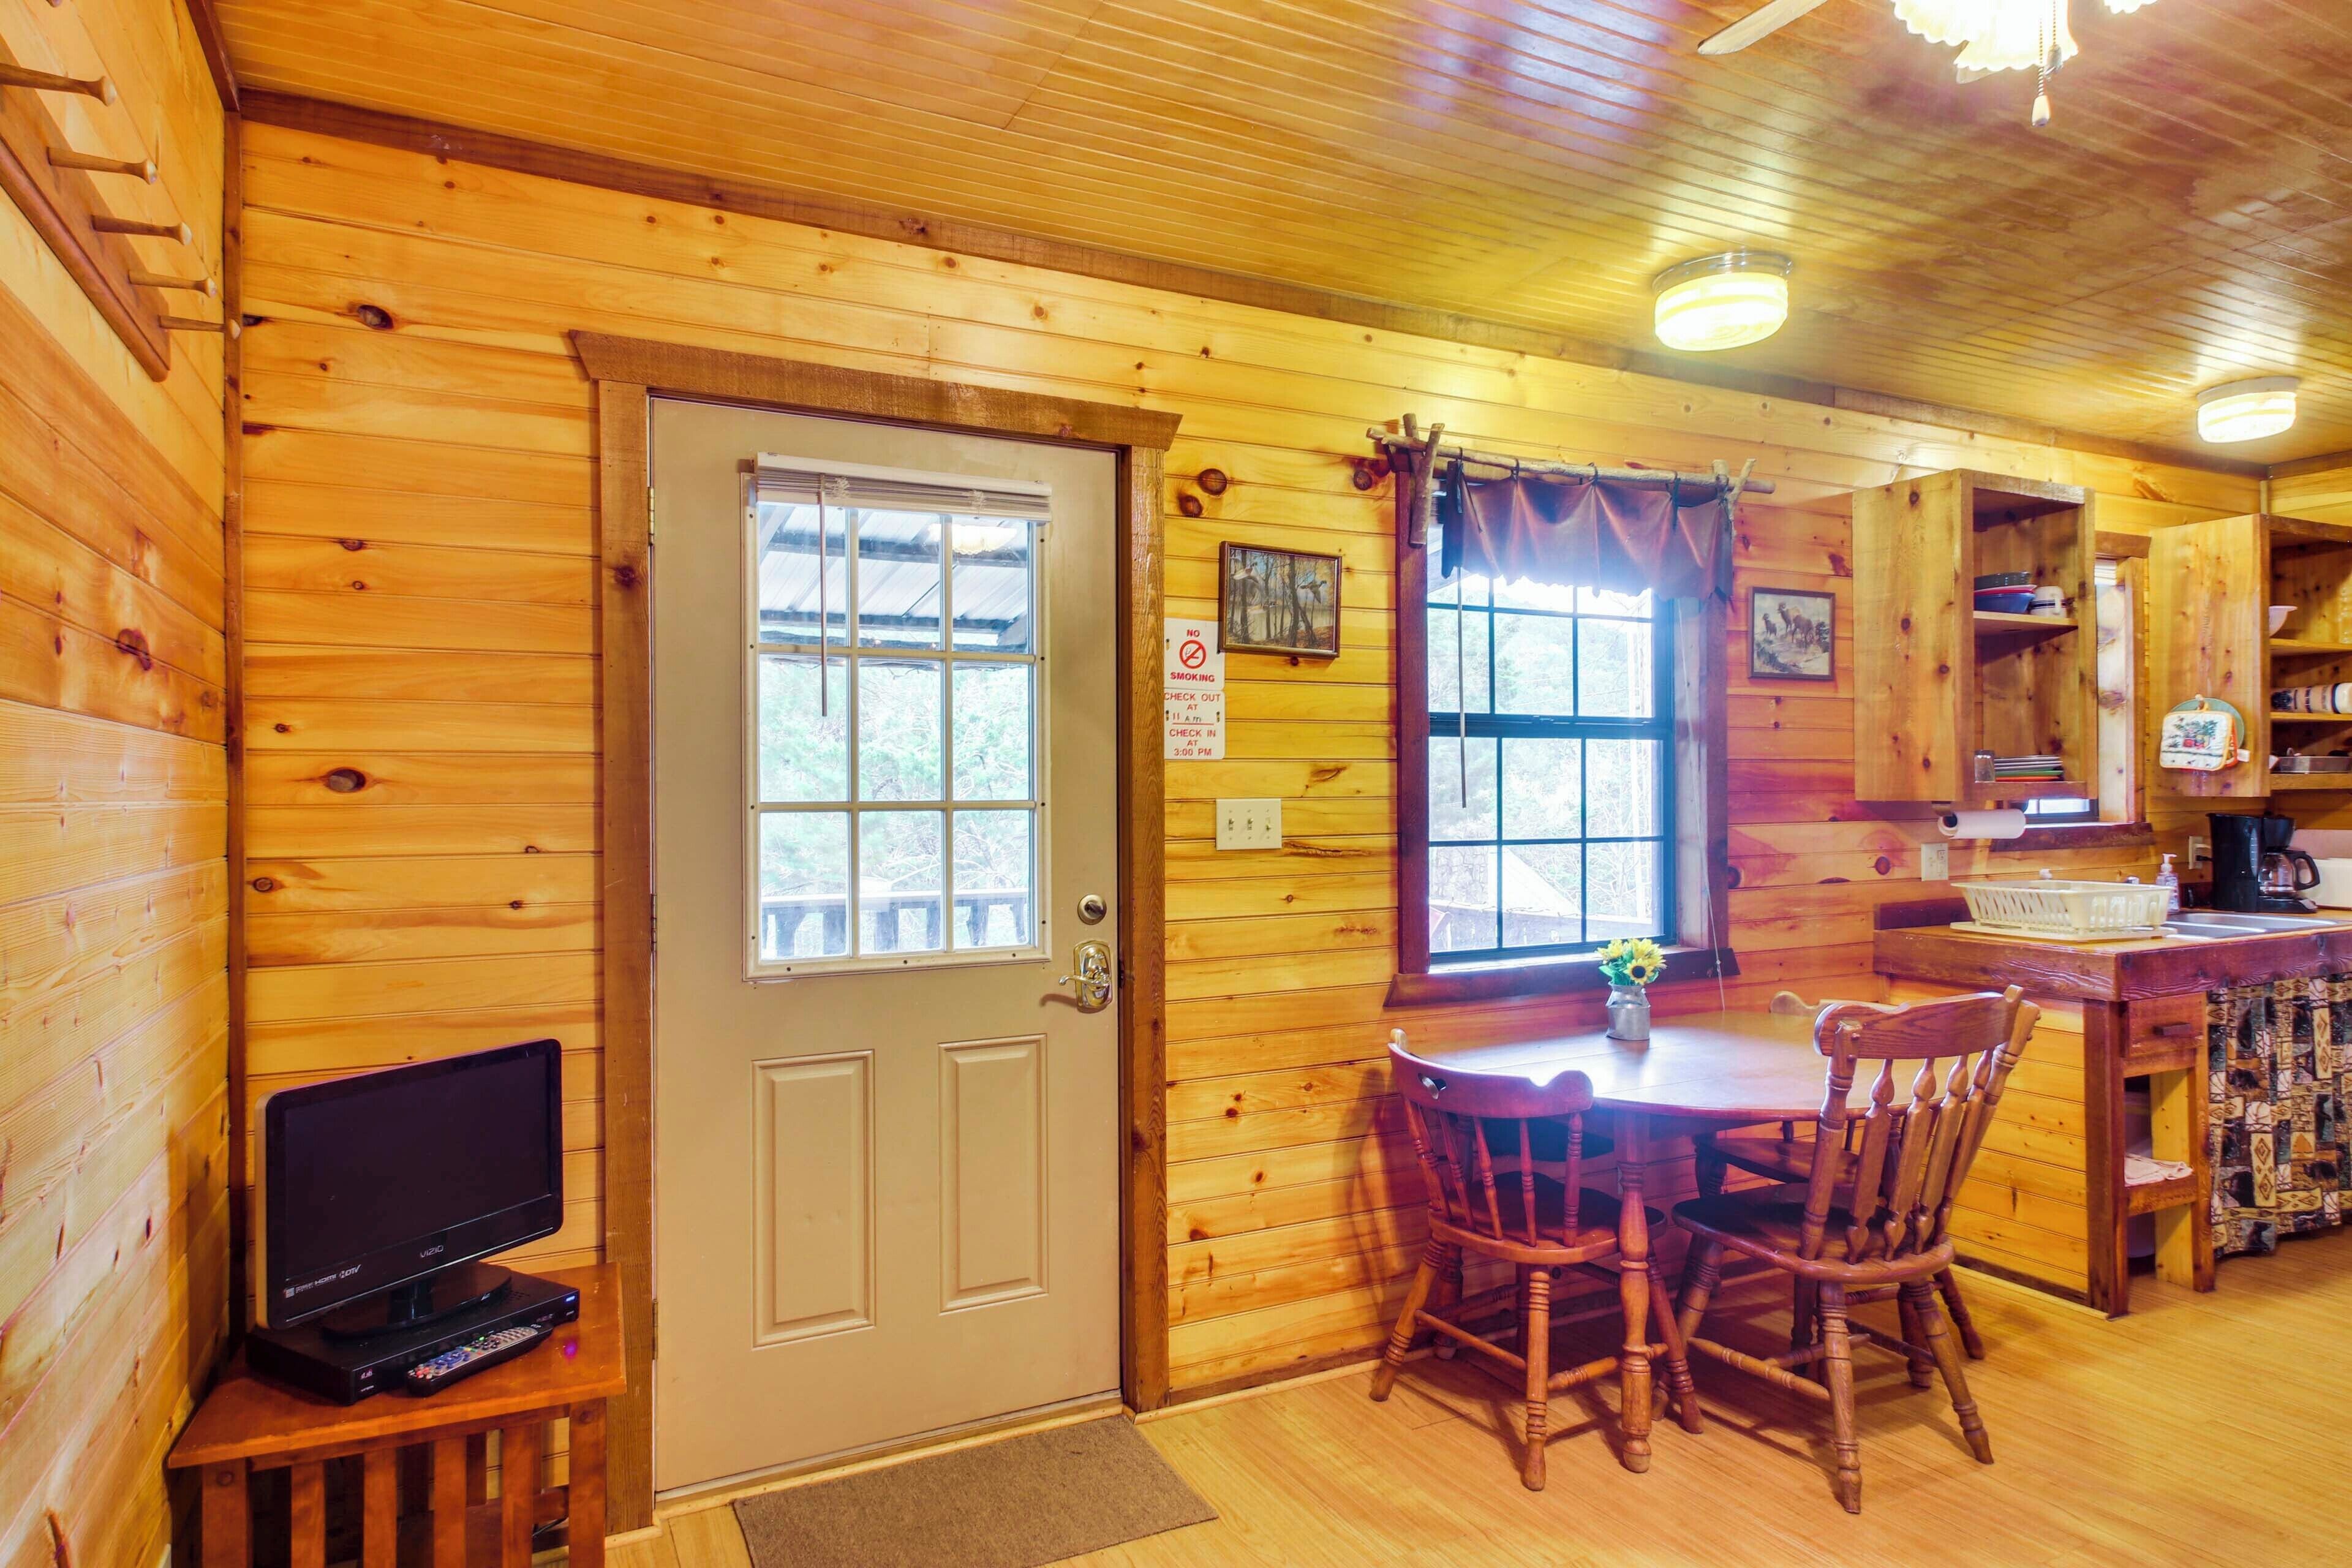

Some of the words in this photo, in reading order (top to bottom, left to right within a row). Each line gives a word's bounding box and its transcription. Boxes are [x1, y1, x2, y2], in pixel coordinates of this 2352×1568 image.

[1186, 629, 1200, 638] NO
[1170, 671, 1215, 682] SMOKING
[1164, 692, 1196, 701] CHECK
[1169, 729, 1202, 737] CHECK
[420, 1245, 444, 1258] VIZIO
